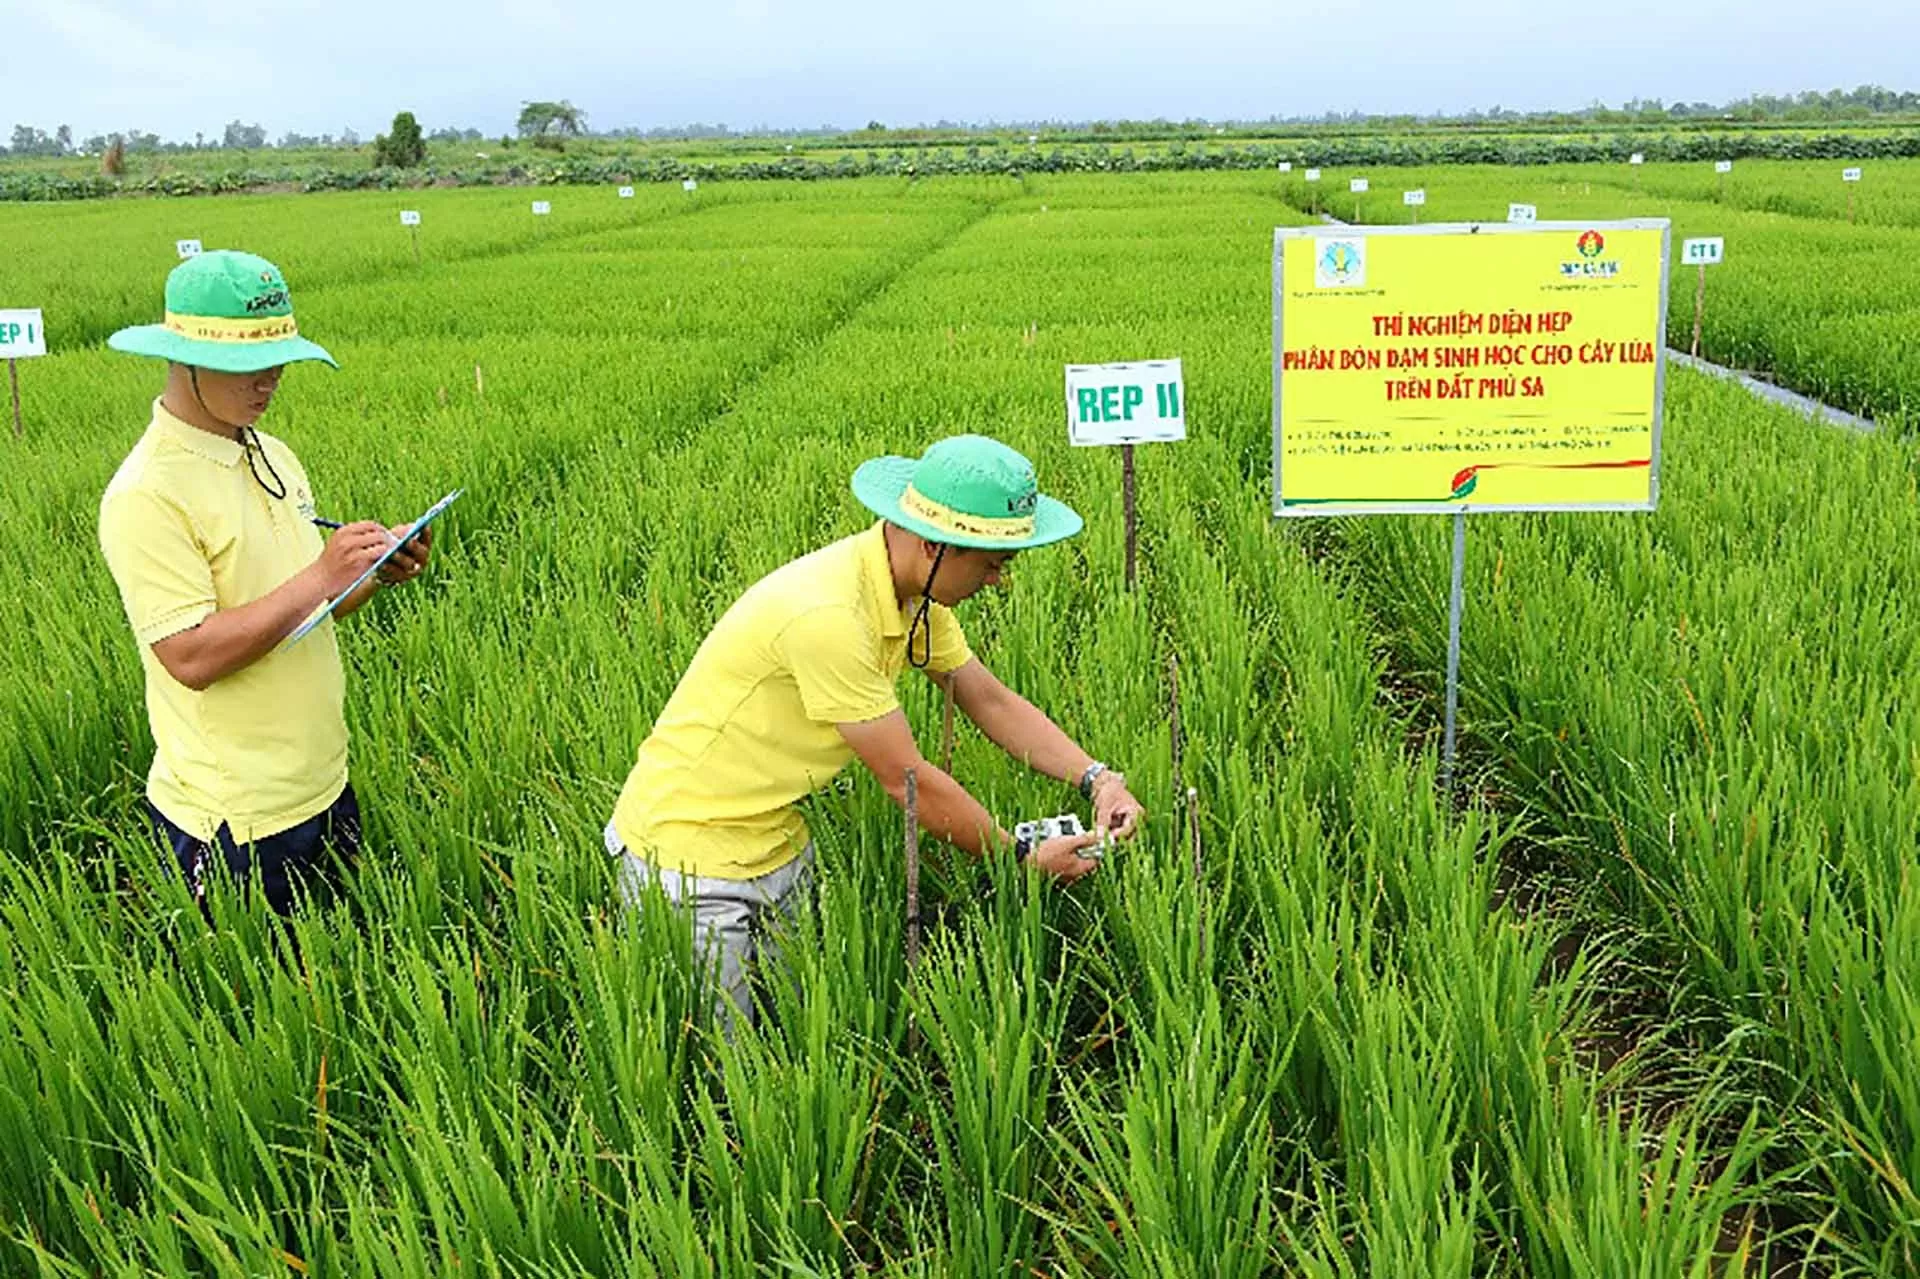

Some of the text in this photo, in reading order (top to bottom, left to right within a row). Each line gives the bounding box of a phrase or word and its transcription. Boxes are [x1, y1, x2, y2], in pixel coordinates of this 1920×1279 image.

[1434, 345, 1480, 370] SINH
[1484, 344, 1527, 370] HỌC
[1531, 344, 1573, 366] CHO
[1520, 376, 1545, 398] SA
[1077, 381, 1180, 423] REP II
